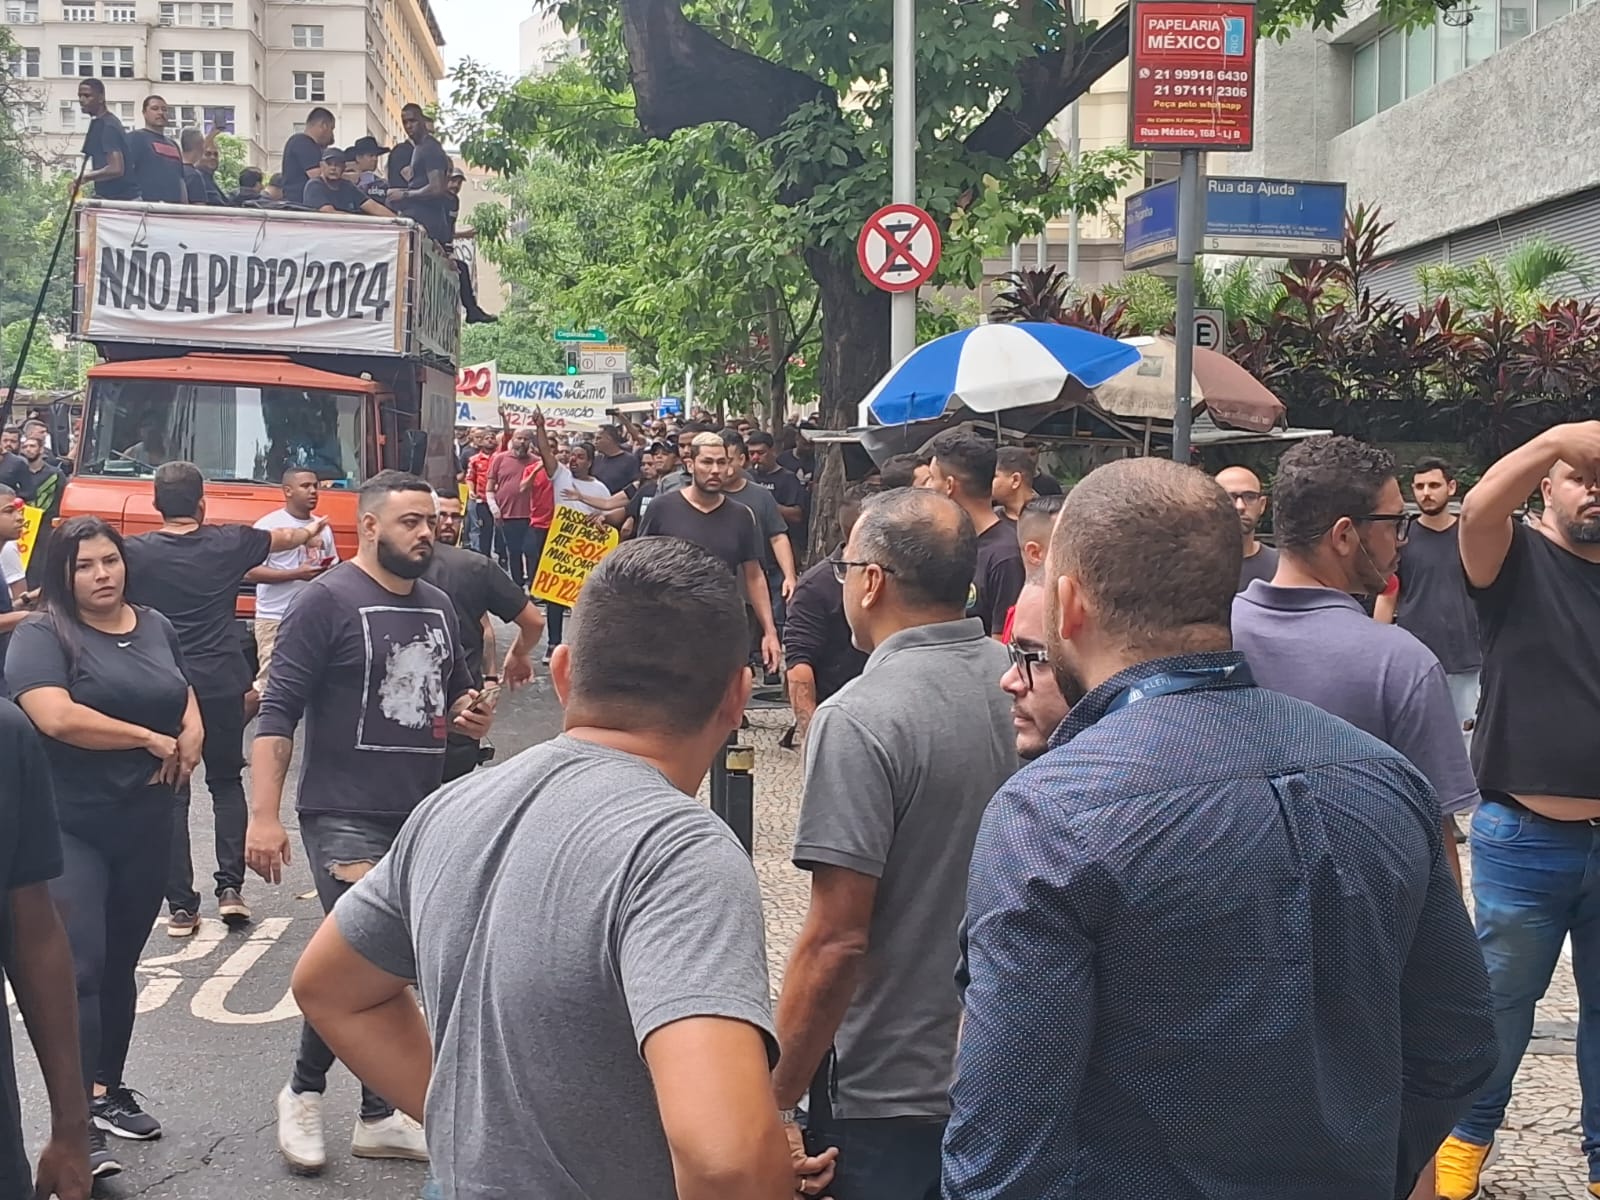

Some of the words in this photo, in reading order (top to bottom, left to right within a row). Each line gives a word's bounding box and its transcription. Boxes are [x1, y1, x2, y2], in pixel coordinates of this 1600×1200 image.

[1148, 19, 1220, 31] PAPELARIA
[1148, 32, 1221, 50] MÉXICO
[1154, 69, 1170, 80] 21
[1174, 69, 1214, 81] 99918
[1217, 70, 1248, 82] 6430
[1154, 85, 1170, 96] 21
[1174, 85, 1213, 96] 97111
[1216, 86, 1248, 98] 2306
[1153, 100, 1176, 109] Peça
[1178, 100, 1197, 109] pelo
[1140, 127, 1159, 136] Rua
[1208, 180, 1234, 193] Rua
[1237, 181, 1254, 194] da
[1257, 181, 1295, 197] Ajuda
[1212, 239, 1219, 249] 5
[98, 242, 172, 312] NÃO
[176, 243, 199, 312] À
[1196, 323, 1212, 346] E
[498, 380, 564, 400] TORISTAS
[506, 412, 566, 428] 12/224
[569, 538, 608, 560] 30%
[545, 547, 573, 564] MAIS
[573, 557, 599, 571] CAR
[552, 563, 576, 577] COM
[576, 571, 586, 579] A
[534, 570, 559, 593] PLP
[556, 578, 583, 603] 12/
